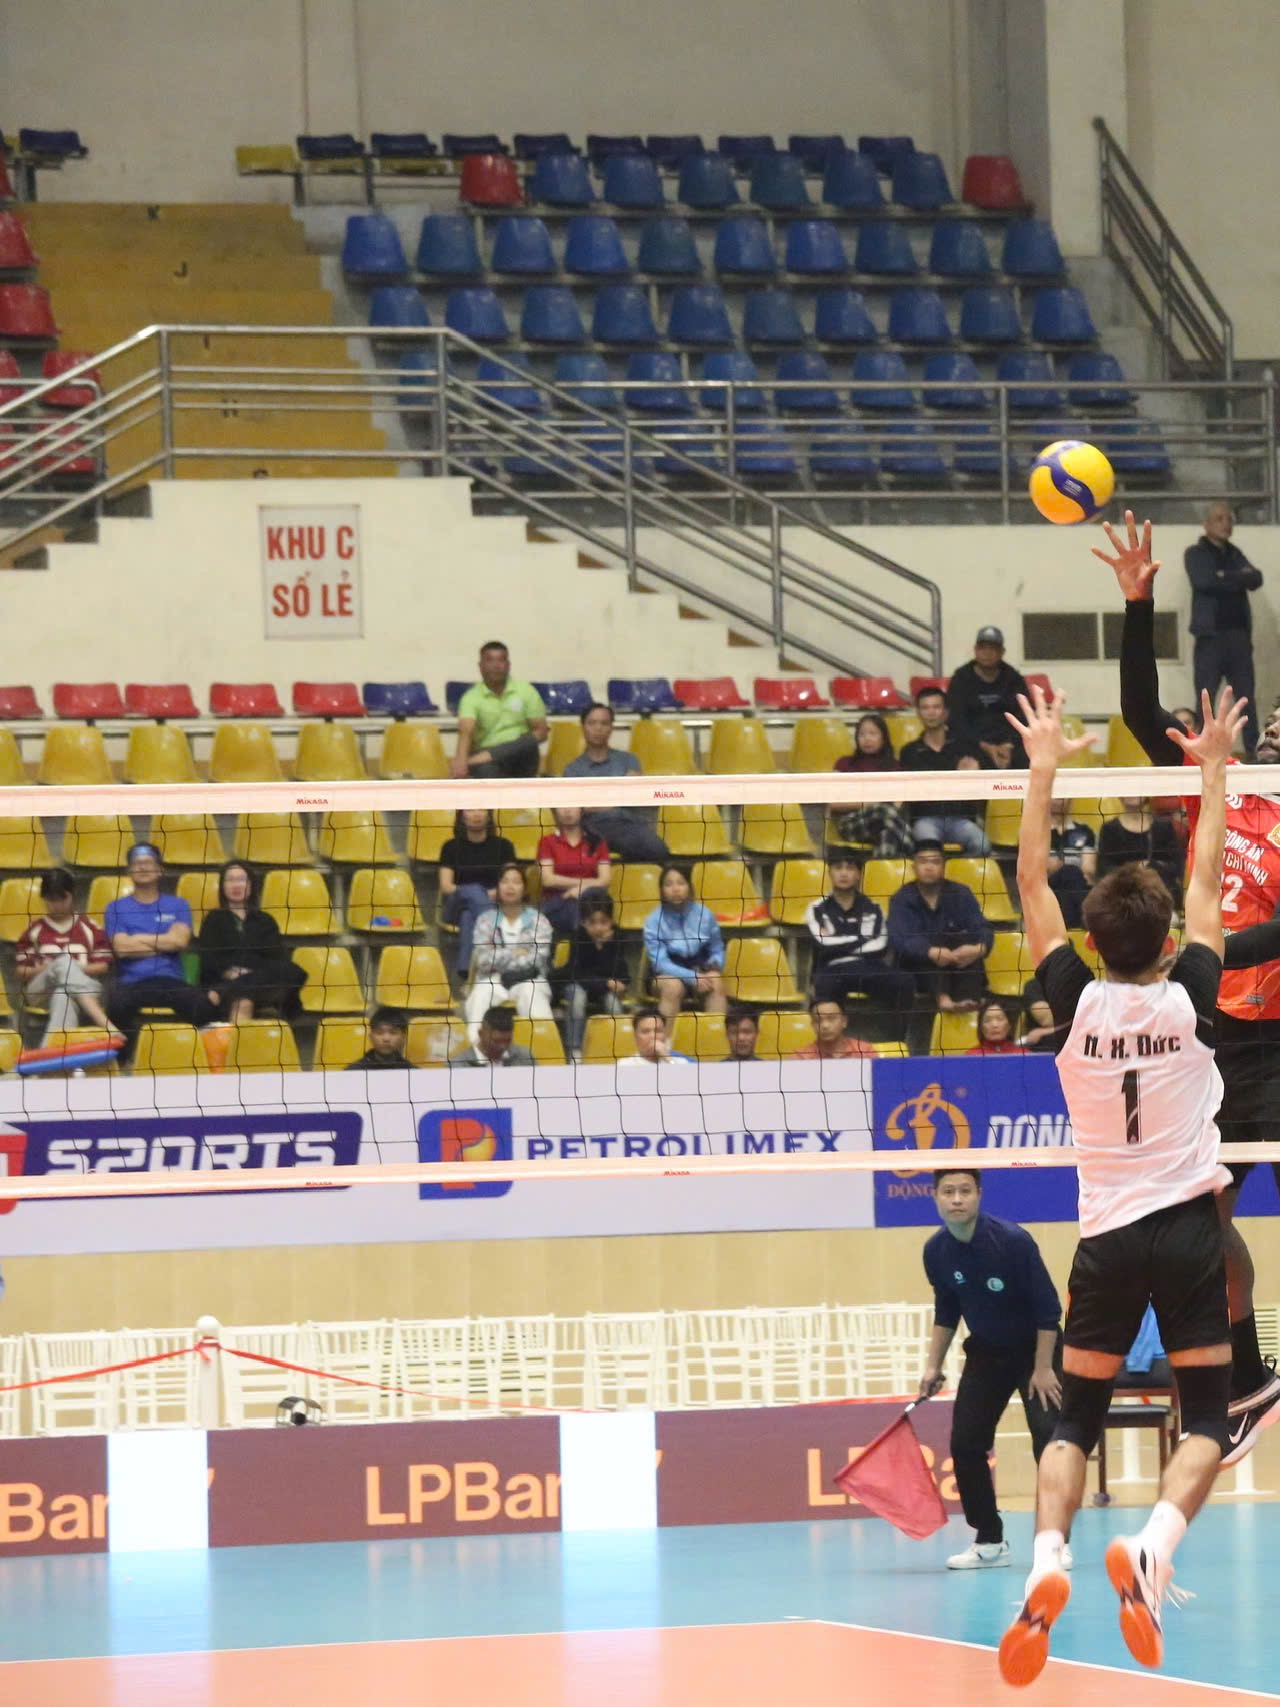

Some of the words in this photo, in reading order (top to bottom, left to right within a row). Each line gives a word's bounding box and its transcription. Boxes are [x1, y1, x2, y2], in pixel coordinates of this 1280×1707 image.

[266, 525, 326, 561] KHU
[335, 524, 355, 560] C
[271, 570, 311, 618] SỐ
[320, 569, 354, 617] LẺ
[1121, 1069, 1142, 1144] 1
[45, 1130, 338, 1176] SPORTS
